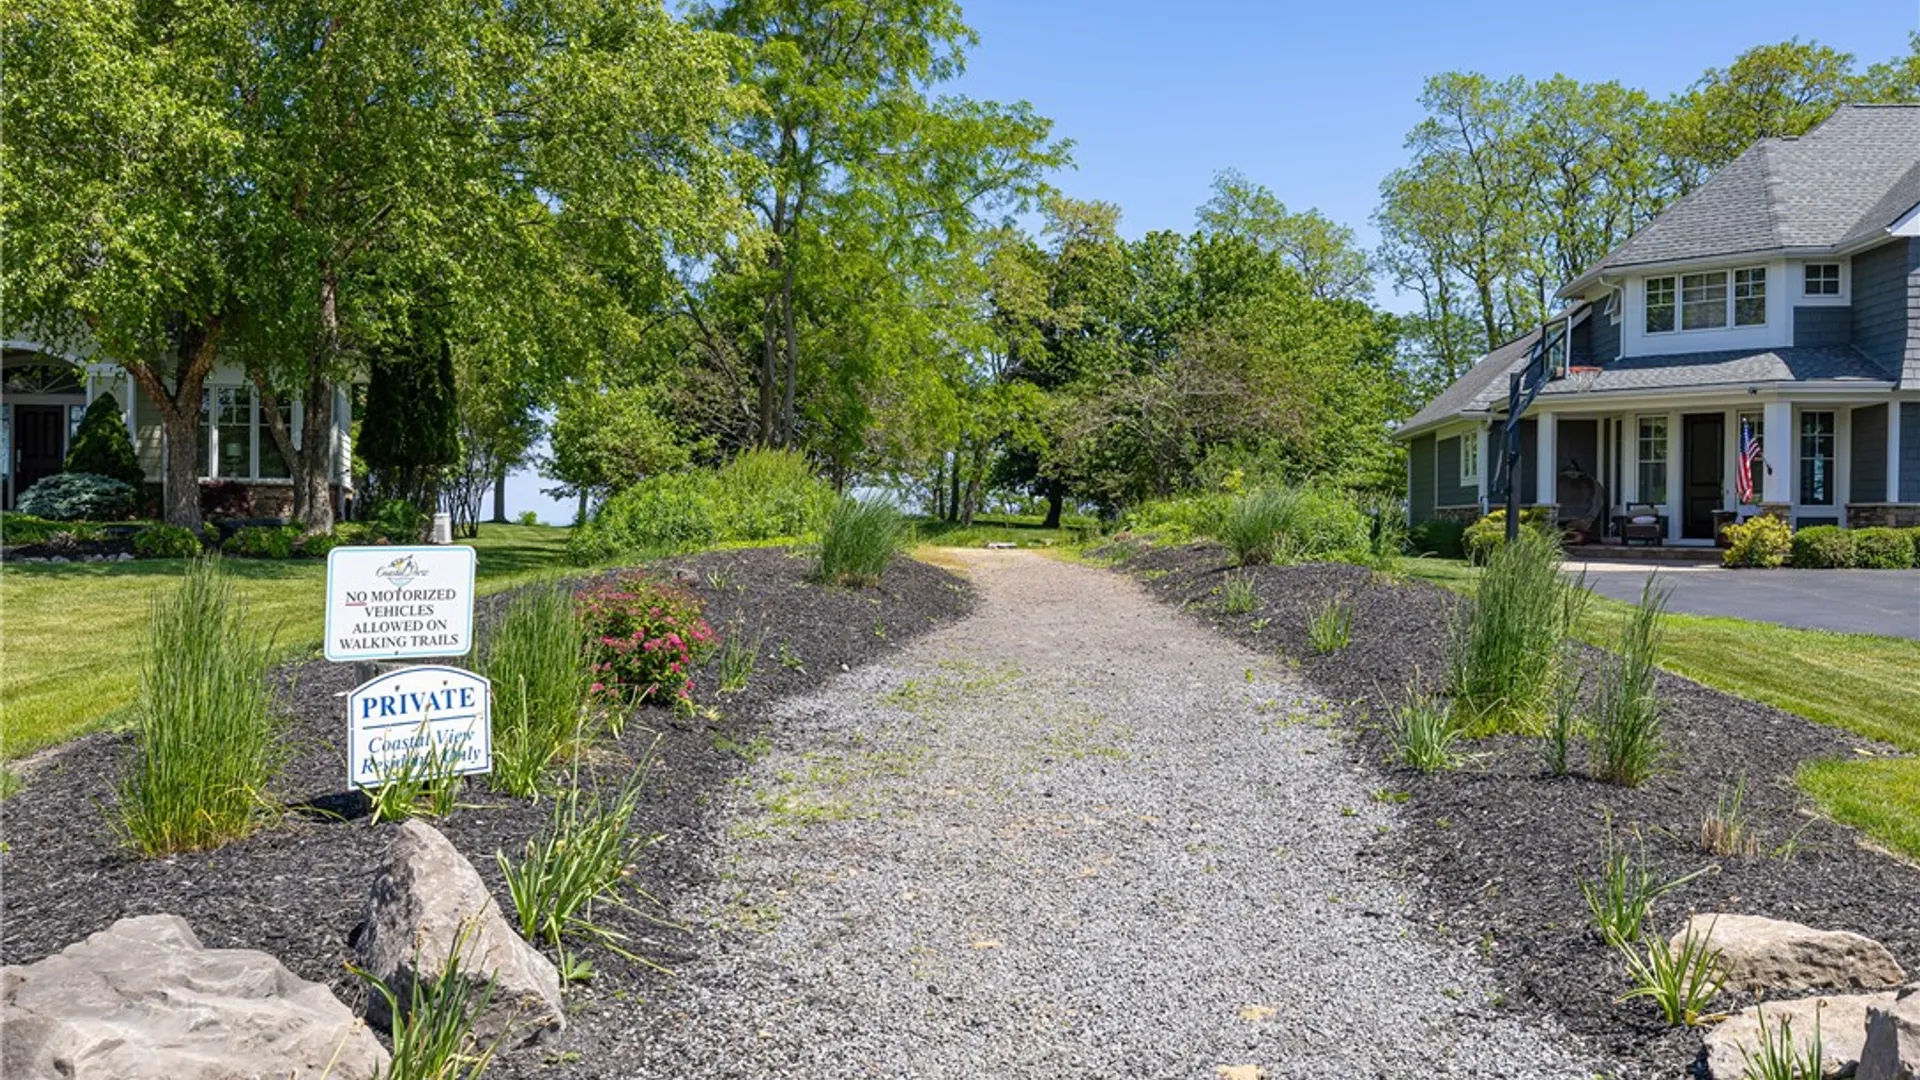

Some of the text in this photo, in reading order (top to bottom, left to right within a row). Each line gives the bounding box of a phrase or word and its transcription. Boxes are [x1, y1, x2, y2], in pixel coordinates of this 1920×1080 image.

[346, 588, 456, 602] NO MOTORIZED
[365, 604, 434, 617] VEHICLES
[352, 620, 447, 634] ALLOWED ON
[340, 634, 459, 650] WALKING TRAILS
[362, 687, 475, 719] PRIVATE
[368, 728, 475, 753] Coastal View
